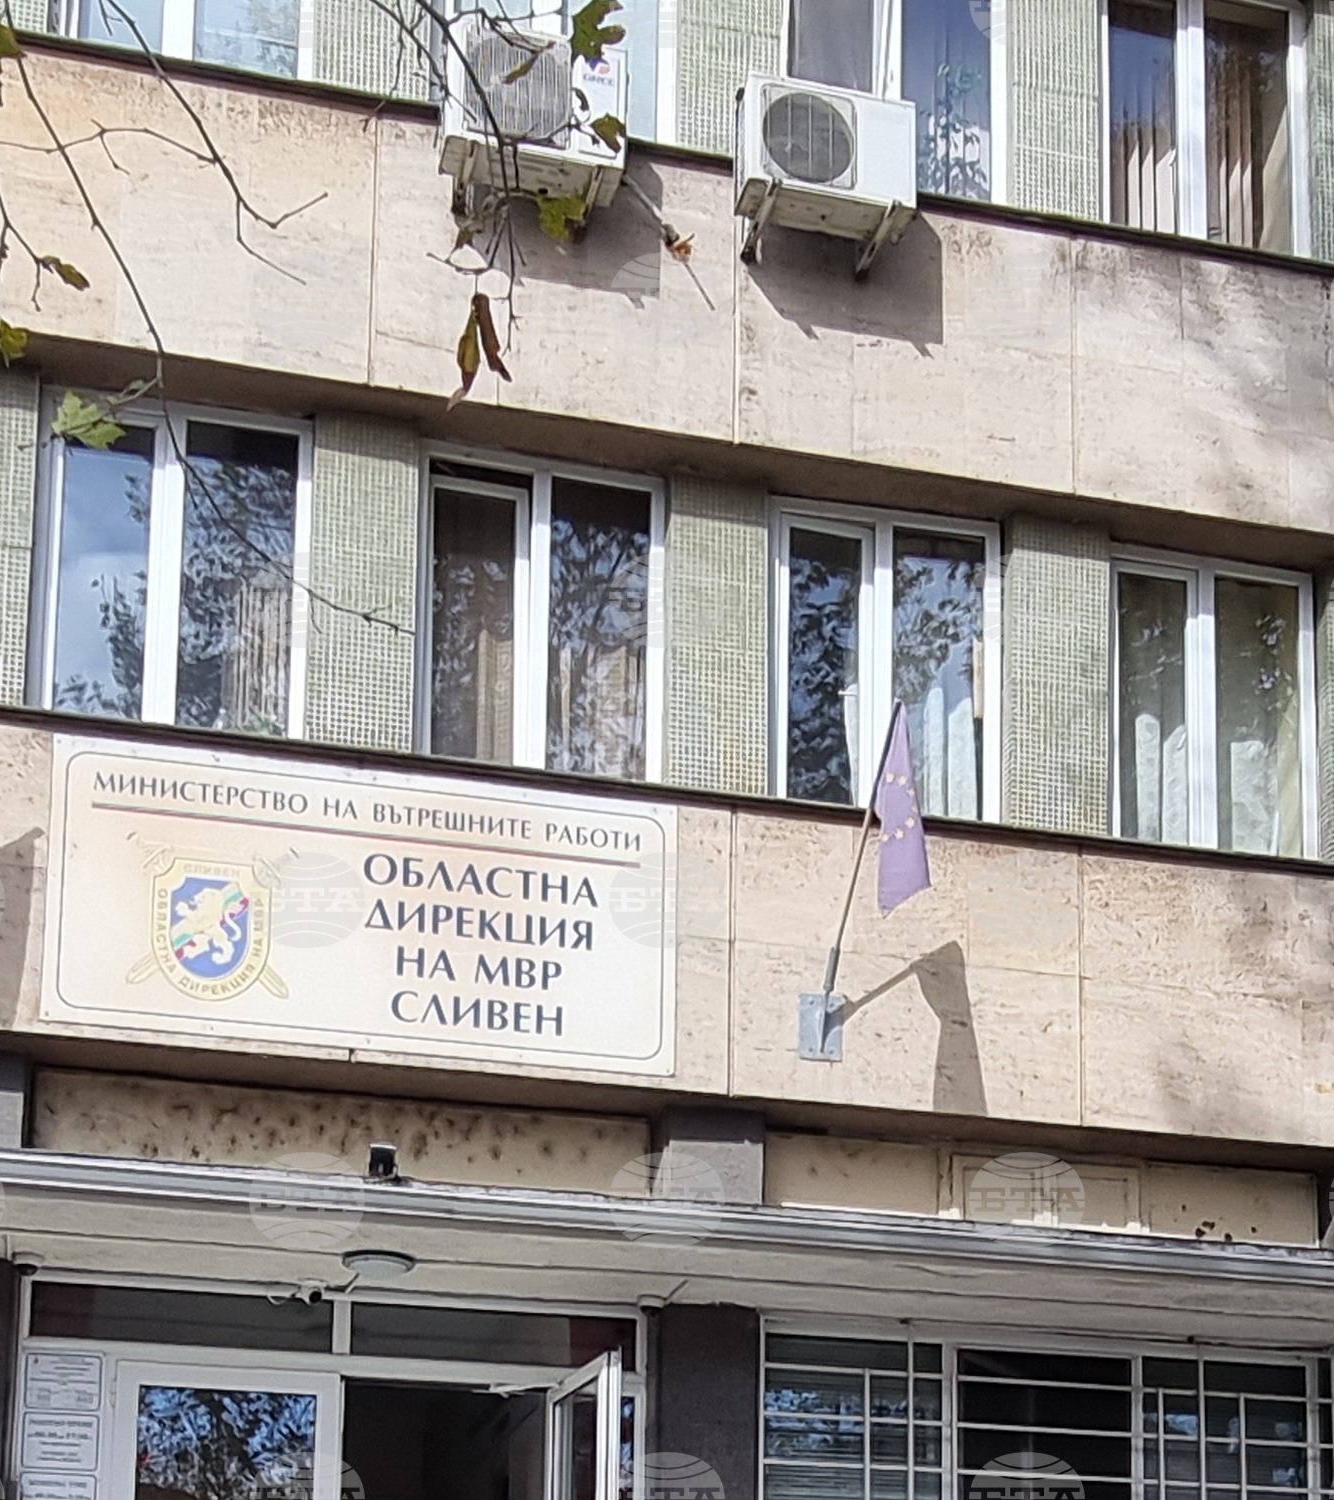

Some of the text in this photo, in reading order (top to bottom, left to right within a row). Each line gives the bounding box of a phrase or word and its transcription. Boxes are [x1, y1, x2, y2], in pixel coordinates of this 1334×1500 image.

[92, 771, 642, 853] МИНИСТЕРСТВО НА ВЪТРЕШНИТЕ РАБОТИ
[363, 853, 599, 908] ОБЛАСТНА
[364, 899, 594, 952] ДИРЕКЦИЯ
[396, 947, 563, 992] НА МВР
[391, 991, 565, 1038] СЛИВЕН
